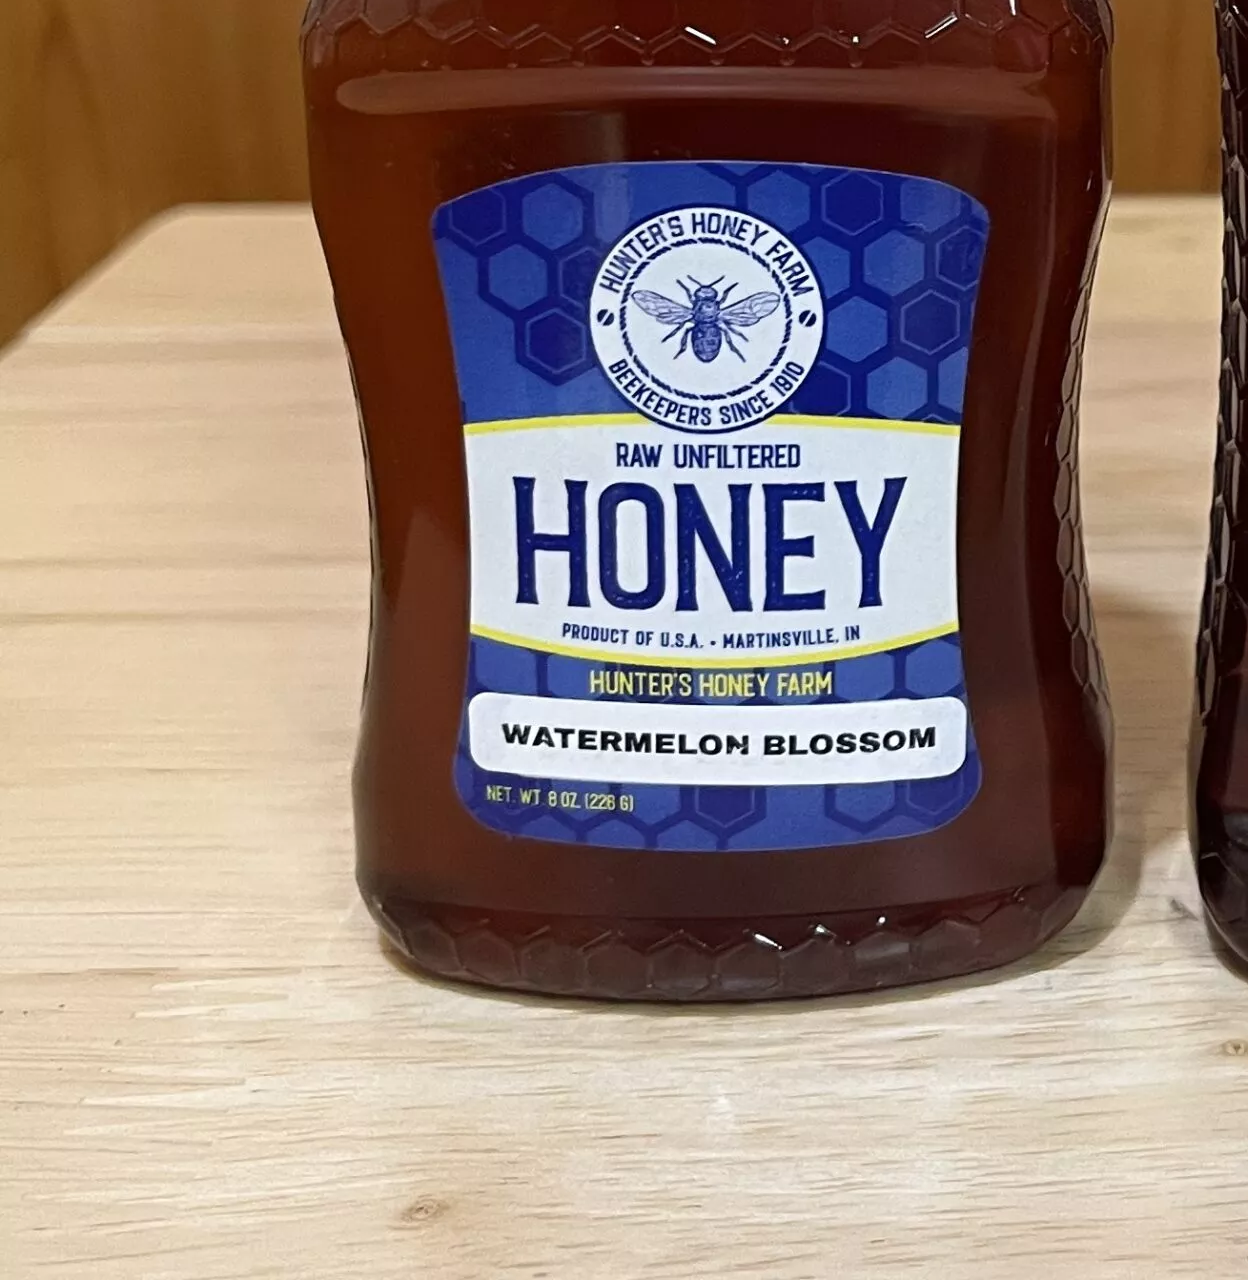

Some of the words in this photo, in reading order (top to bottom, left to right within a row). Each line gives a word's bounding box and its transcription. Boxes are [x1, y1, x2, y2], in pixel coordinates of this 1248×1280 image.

[599, 215, 684, 293] HUNTER'S
[691, 212, 769, 246] HONEY
[765, 240, 814, 297] FARM
[608, 358, 711, 426] BEEKEEPERS
[719, 390, 774, 425] SINCE
[770, 361, 805, 397] 1910
[616, 444, 662, 468] RAW
[674, 443, 801, 469] UNFILTERED
[512, 475, 908, 613] HONEY
[562, 622, 629, 645] PRODUCT
[635, 630, 654, 646] OF
[660, 632, 703, 648] U.S.A.
[845, 624, 861, 641] IN
[589, 669, 692, 697] HUNTER'S
[699, 671, 769, 697] HONEY
[776, 670, 833, 697] FARM
[501, 722, 750, 756] WATERMELON
[763, 725, 937, 756] BLOSSOM
[548, 790, 558, 807] 8
[619, 794, 634, 812] G)
